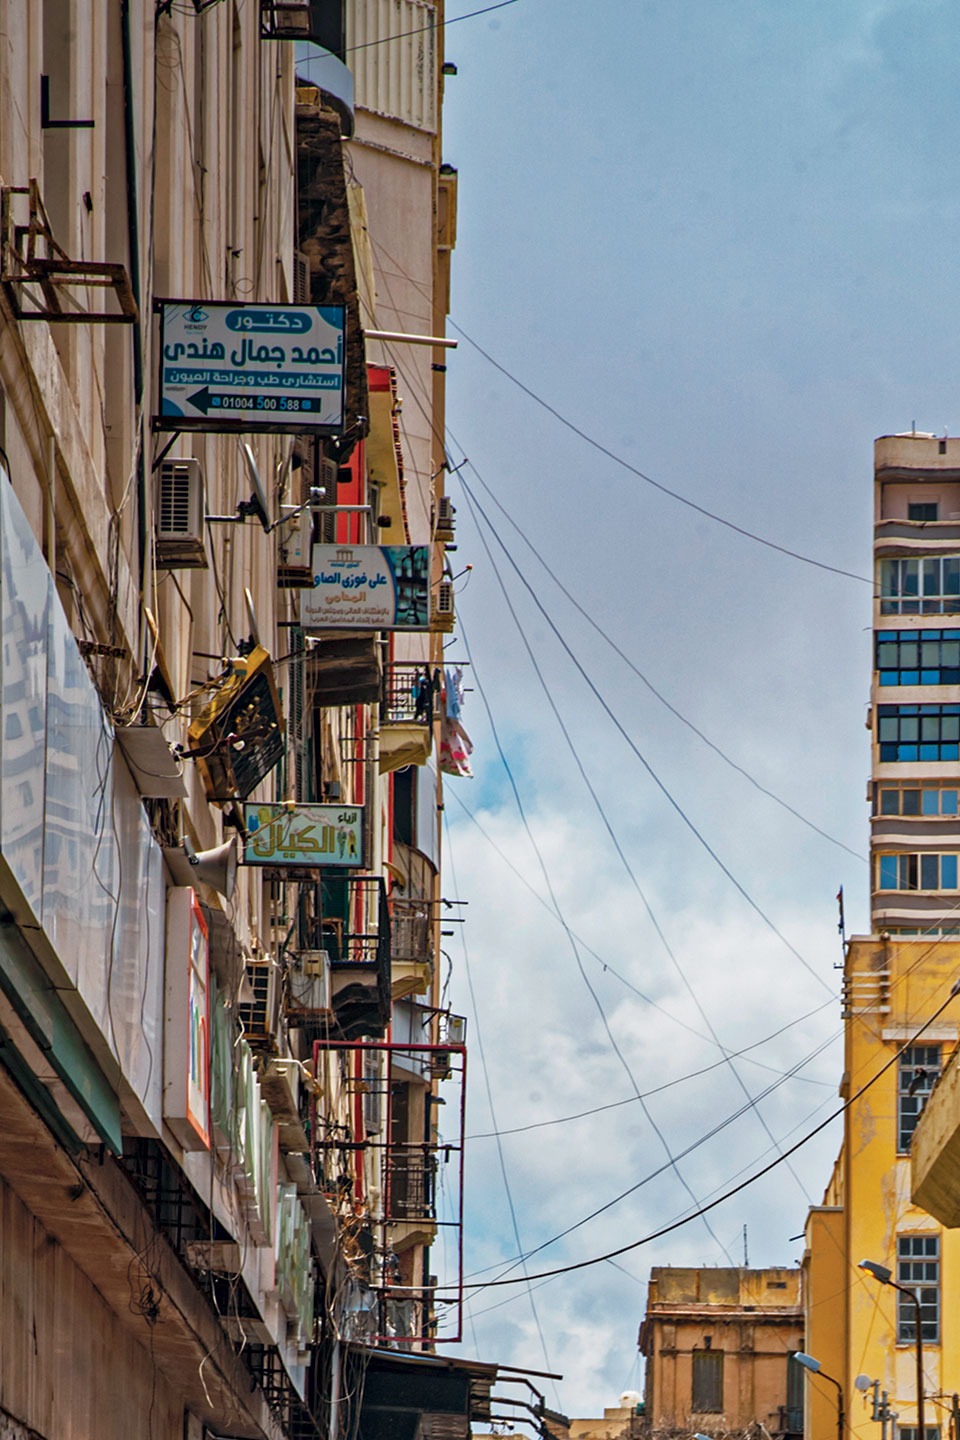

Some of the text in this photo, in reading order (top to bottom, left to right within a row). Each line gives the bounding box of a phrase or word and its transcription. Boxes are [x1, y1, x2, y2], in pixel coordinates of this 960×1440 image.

[235, 314, 303, 329] دكتور
[231, 339, 286, 369] جمال
[291, 335, 343, 365] أحمد
[170, 371, 210, 383] العيون
[213, 372, 256, 385] وجراحة
[257, 375, 279, 386] طب
[222, 396, 299, 410] 01004 500 588
[314, 572, 341, 588] الصاو
[253, 823, 335, 859] الكيال
